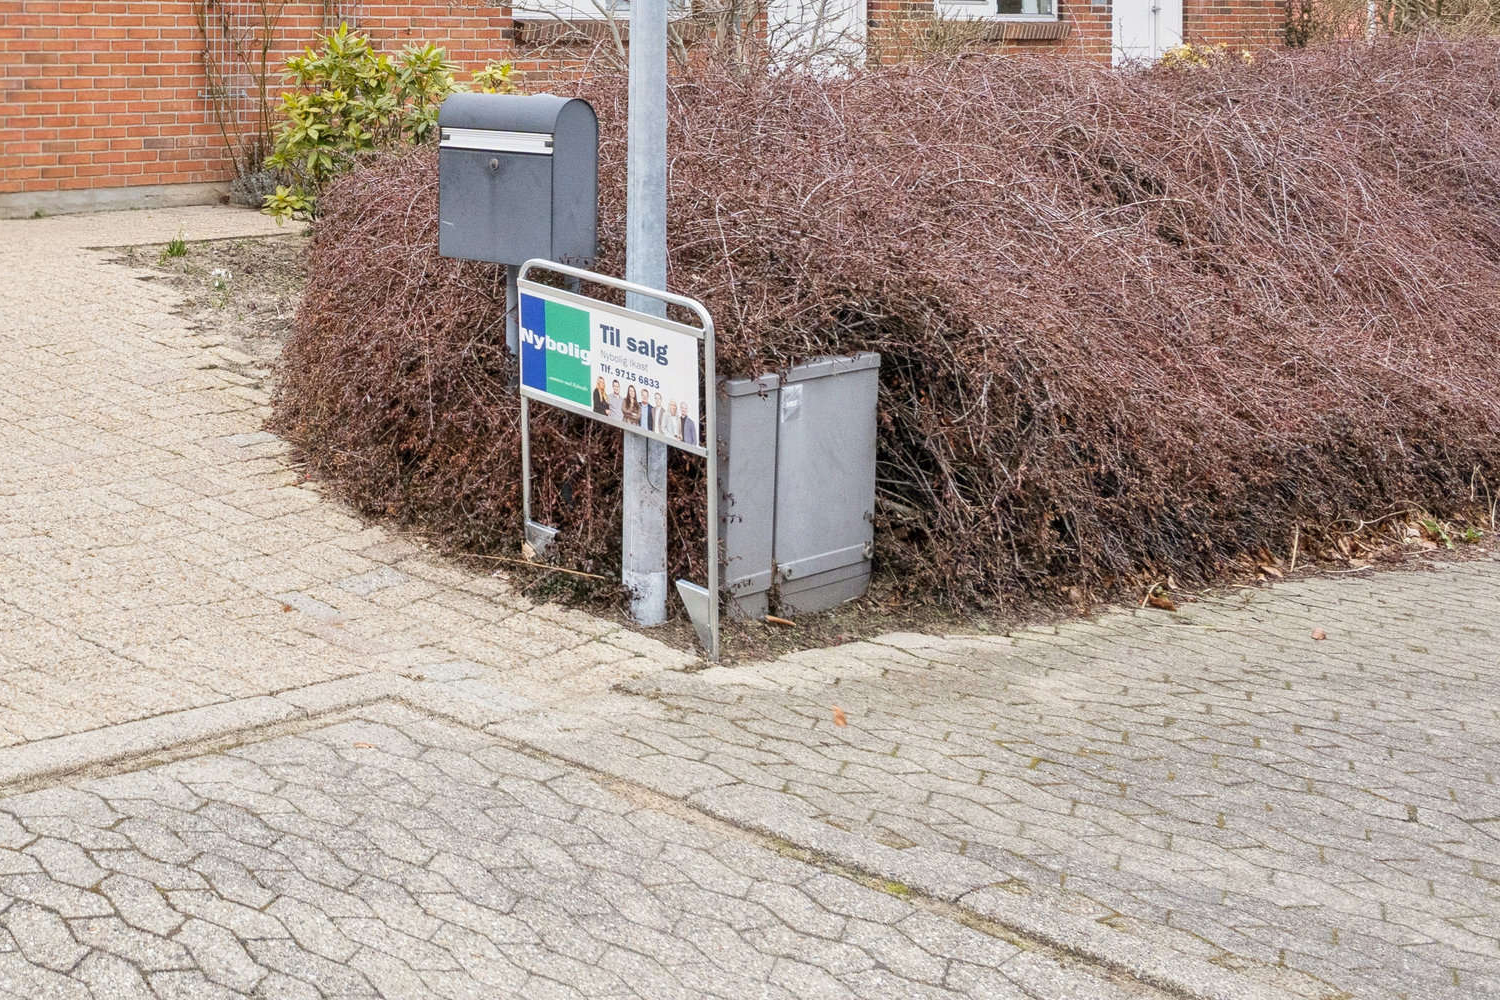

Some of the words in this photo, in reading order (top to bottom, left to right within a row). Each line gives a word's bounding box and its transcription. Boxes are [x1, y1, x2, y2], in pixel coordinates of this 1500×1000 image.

[521, 327, 591, 366] Nybolig
[600, 324, 620, 347] Til
[627, 337, 668, 366] salg
[600, 350, 628, 367] Nybolig
[600, 363, 613, 375] Tlf.
[615, 368, 636, 381] 9715
[638, 376, 660, 389] 6833
